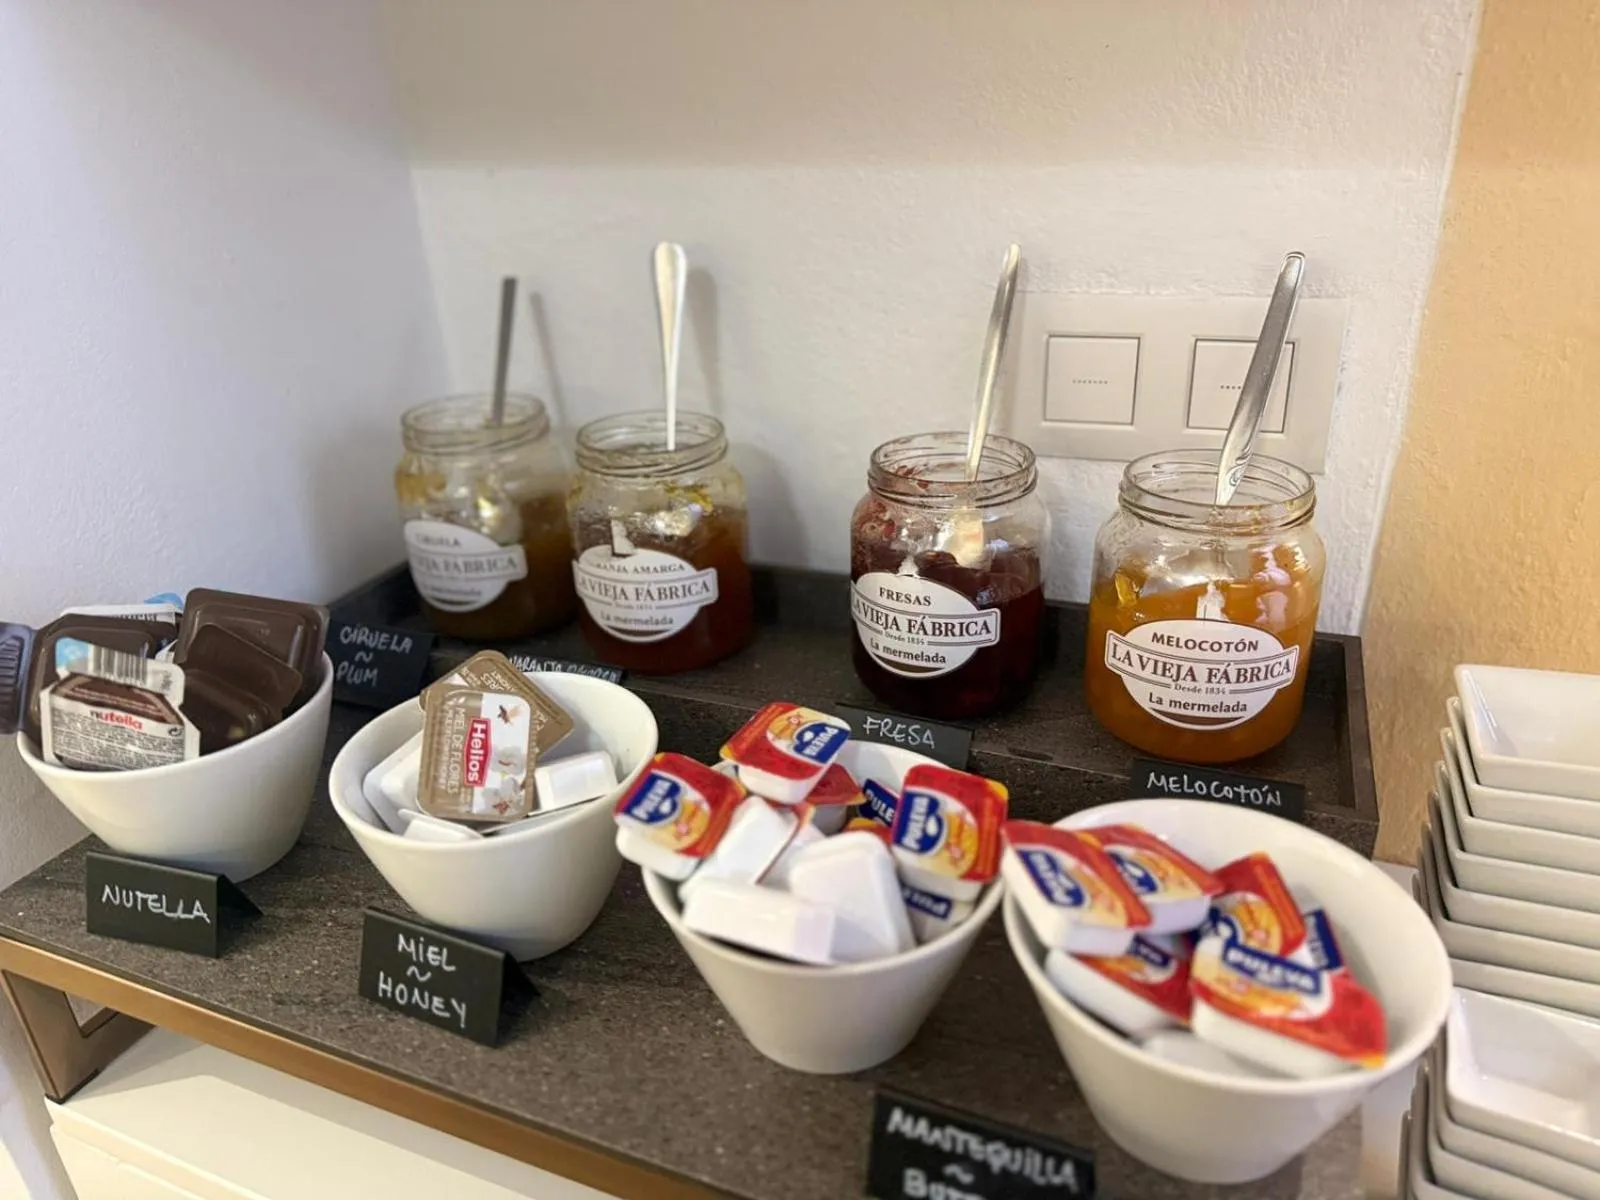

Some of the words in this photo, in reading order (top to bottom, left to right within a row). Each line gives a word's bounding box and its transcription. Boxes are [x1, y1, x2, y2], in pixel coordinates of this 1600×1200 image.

[633, 562, 686, 575] AMARGA
[589, 580, 629, 601] VIEJA
[635, 580, 711, 602] FÁBRICA
[879, 586, 932, 607] FRESAS
[613, 614, 674, 626] mermelada
[861, 603, 902, 632] VIEJA
[907, 616, 992, 638] FÁBRICA
[339, 625, 414, 654] CIRUELA
[869, 636, 880, 651] La
[882, 643, 947, 664] mermelada
[1151, 632, 1260, 653] MELOCOTÓN
[1111, 642, 1134, 668] LA
[1136, 655, 1199, 683] VIEJA
[1205, 659, 1292, 685] FÁBRICA
[1148, 692, 1163, 706] La
[1169, 699, 1248, 713] mermelada
[1174, 683, 1201, 694] Desde
[862, 714, 936, 750] FRESA
[467, 723, 487, 782] Helios
[102, 884, 211, 924] NUTELLA
[378, 970, 467, 1030] HONEY
